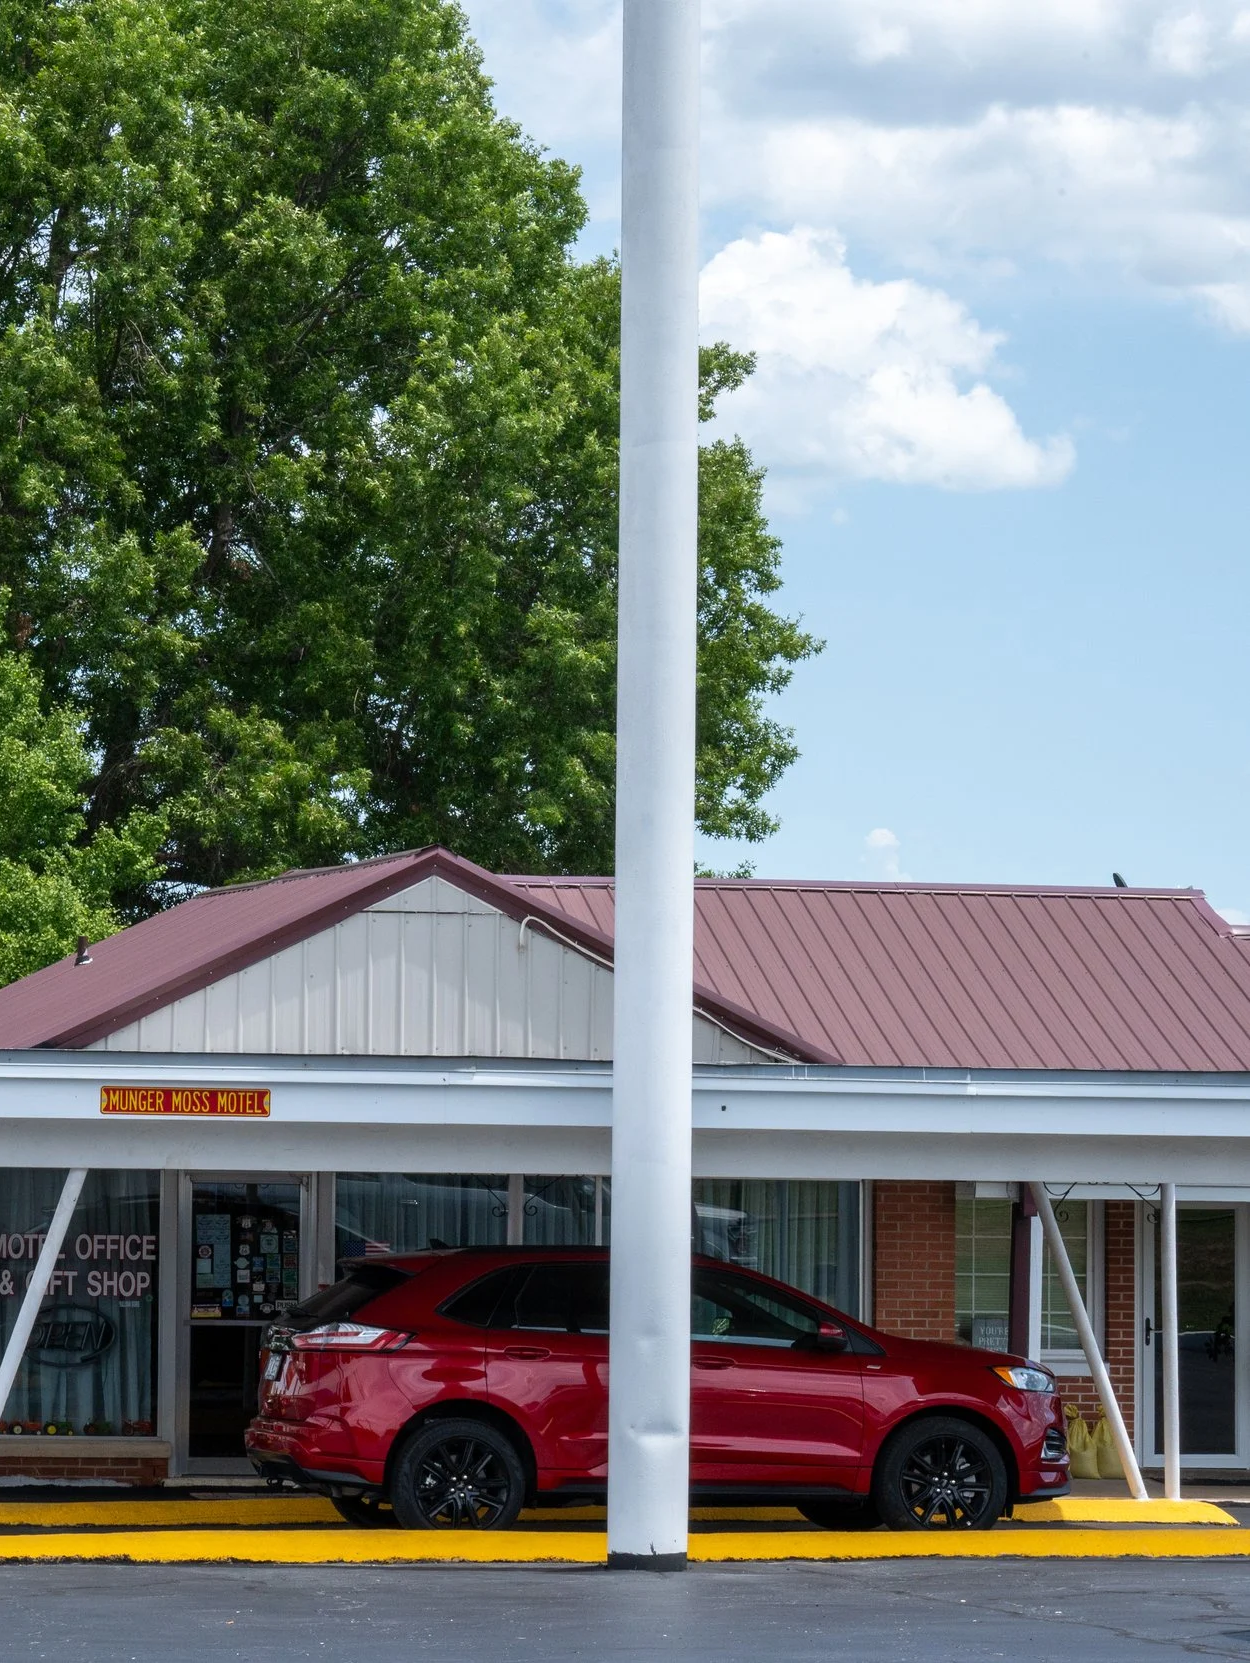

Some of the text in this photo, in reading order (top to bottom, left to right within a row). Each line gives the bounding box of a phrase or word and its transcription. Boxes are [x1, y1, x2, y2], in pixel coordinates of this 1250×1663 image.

[109, 1089, 262, 1114] MUNGER MOSS MOTEL
[75, 1234, 157, 1261] OFFICE
[0, 1269, 151, 1297] & FT SHOP
